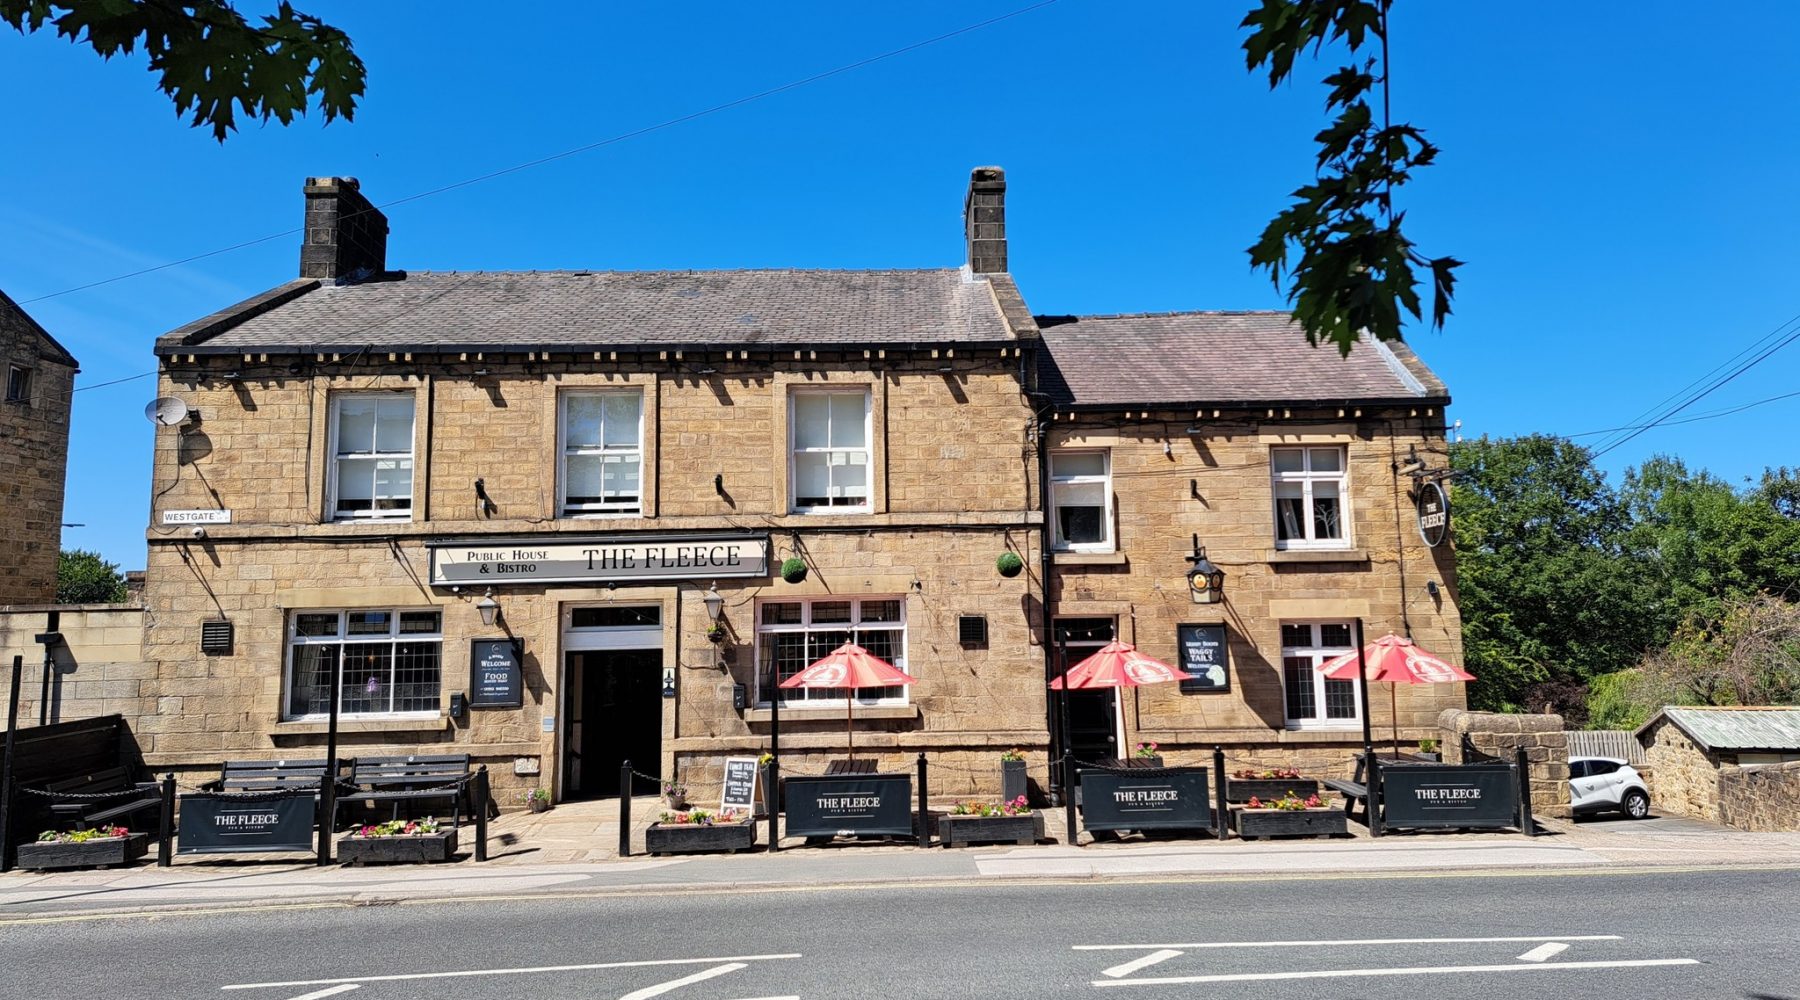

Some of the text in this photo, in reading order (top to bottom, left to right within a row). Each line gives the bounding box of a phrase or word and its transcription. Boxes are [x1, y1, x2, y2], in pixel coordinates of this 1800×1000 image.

[1426, 502, 1437, 513] THE
[164, 512, 214, 520] WESTGATE
[1421, 512, 1444, 528] FLEECE
[467, 550, 549, 561] PUBLIC HOUSE
[582, 546, 740, 570] THE FLEECE
[480, 562, 536, 574] & BISTRO
[1113, 790, 1178, 802] THE FLEECE
[1414, 788, 1481, 799] THE FLEECE
[816, 797, 880, 808] THE FLEECE
[214, 814, 279, 826] THE FLEECE
